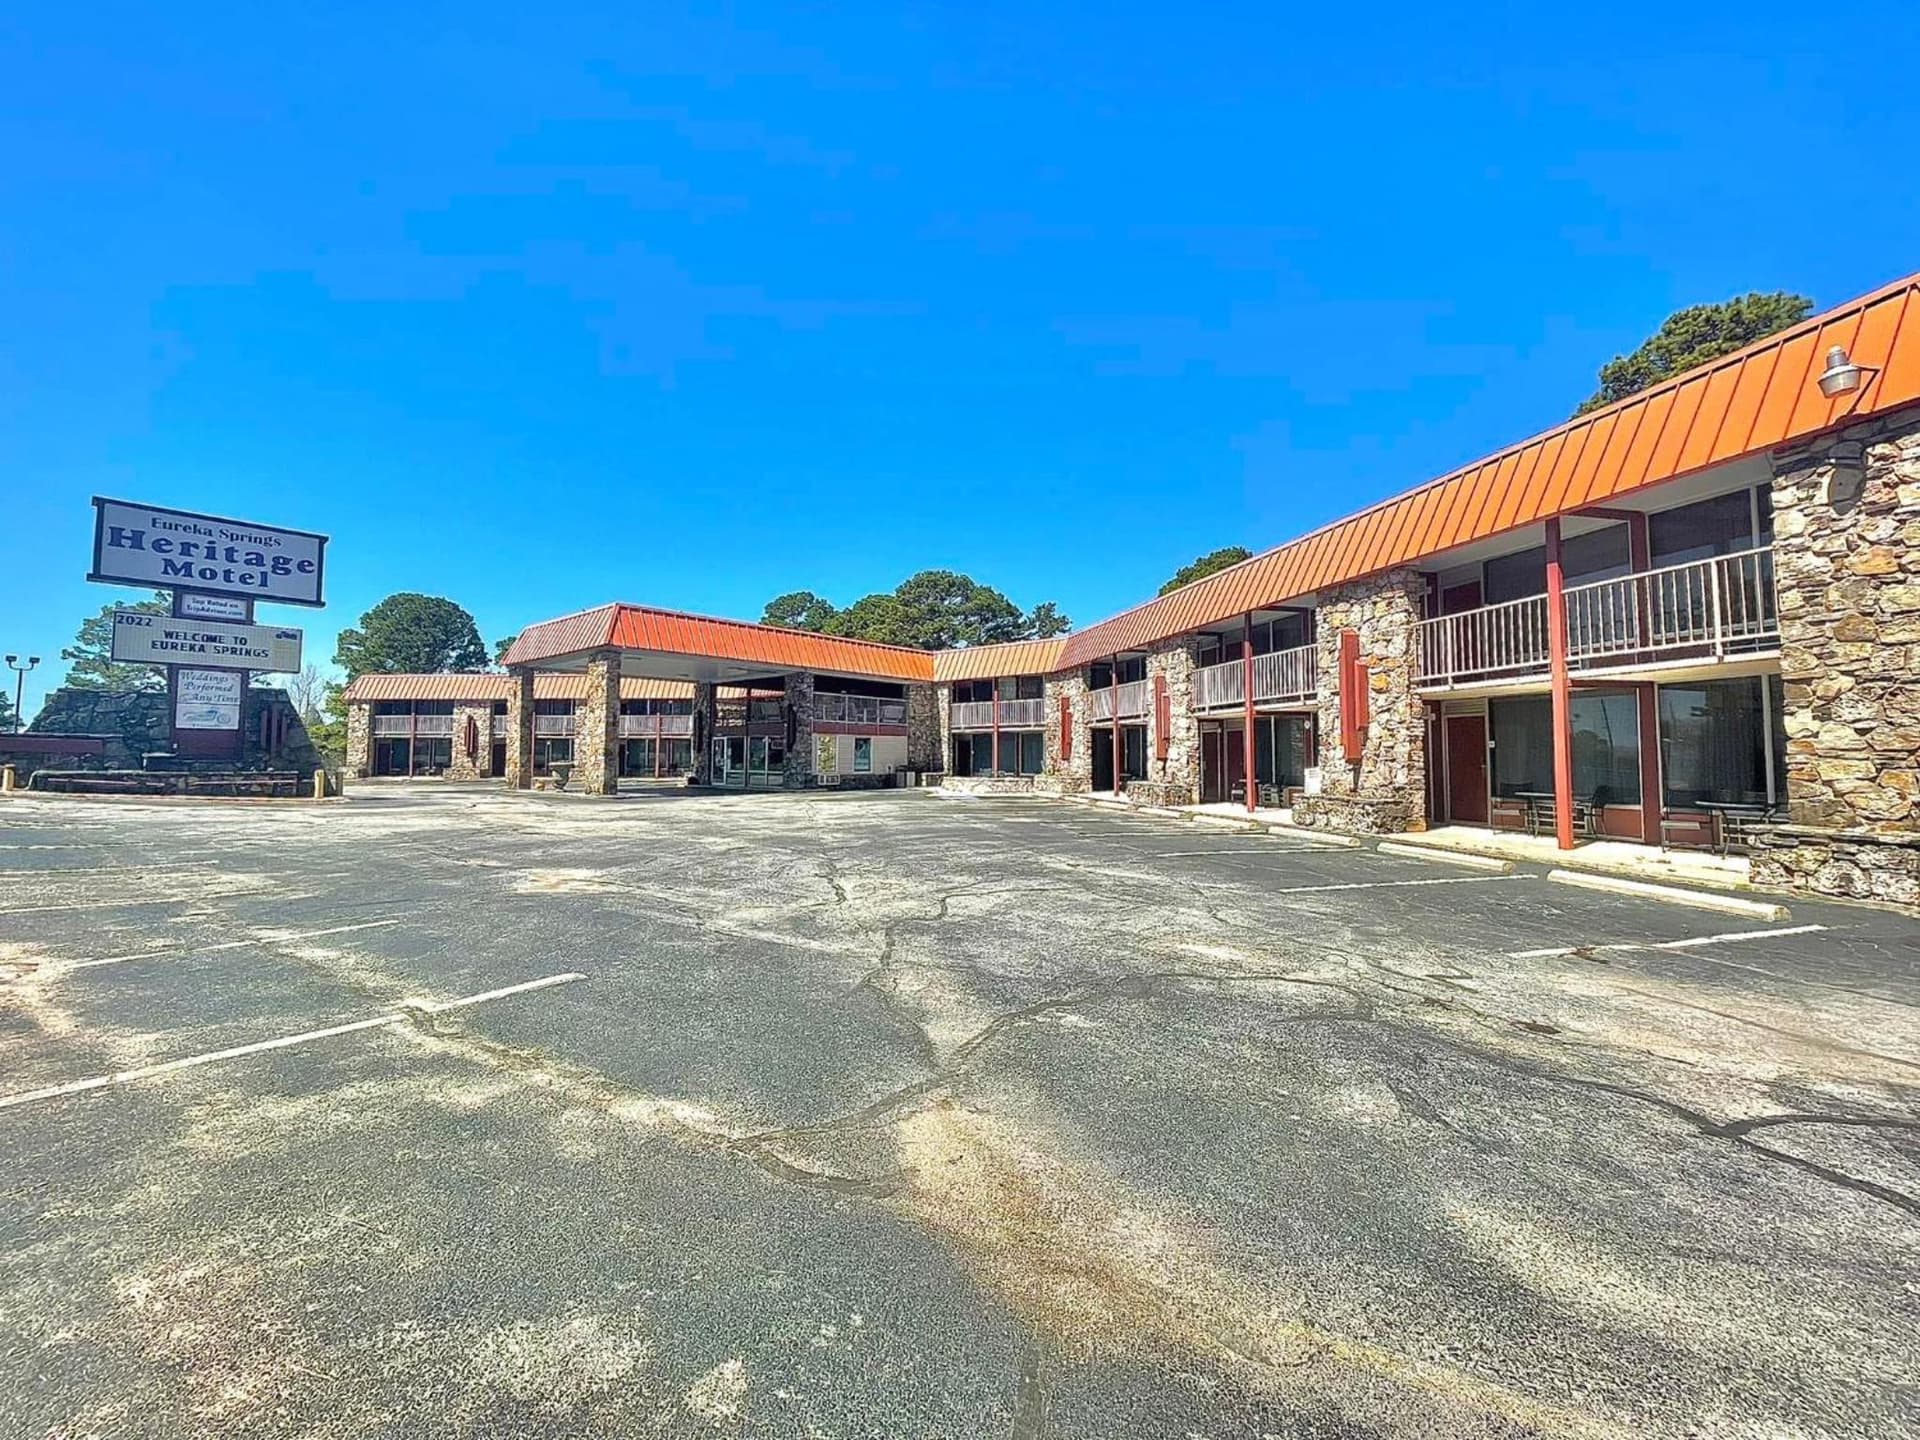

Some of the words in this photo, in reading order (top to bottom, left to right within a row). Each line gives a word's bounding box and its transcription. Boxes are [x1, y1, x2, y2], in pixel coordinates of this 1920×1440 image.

[151, 517, 214, 537] Eureka
[218, 528, 281, 547] Springs
[107, 526, 315, 576] Heritage
[161, 558, 269, 587] Motel
[117, 614, 152, 627] 2022
[163, 630, 226, 645] WELCOME
[233, 635, 248, 646] TO
[151, 640, 206, 653] EUREKA
[213, 644, 269, 658] SPRINGS
[181, 671, 229, 684] Weddings
[183, 681, 234, 693] Performed
